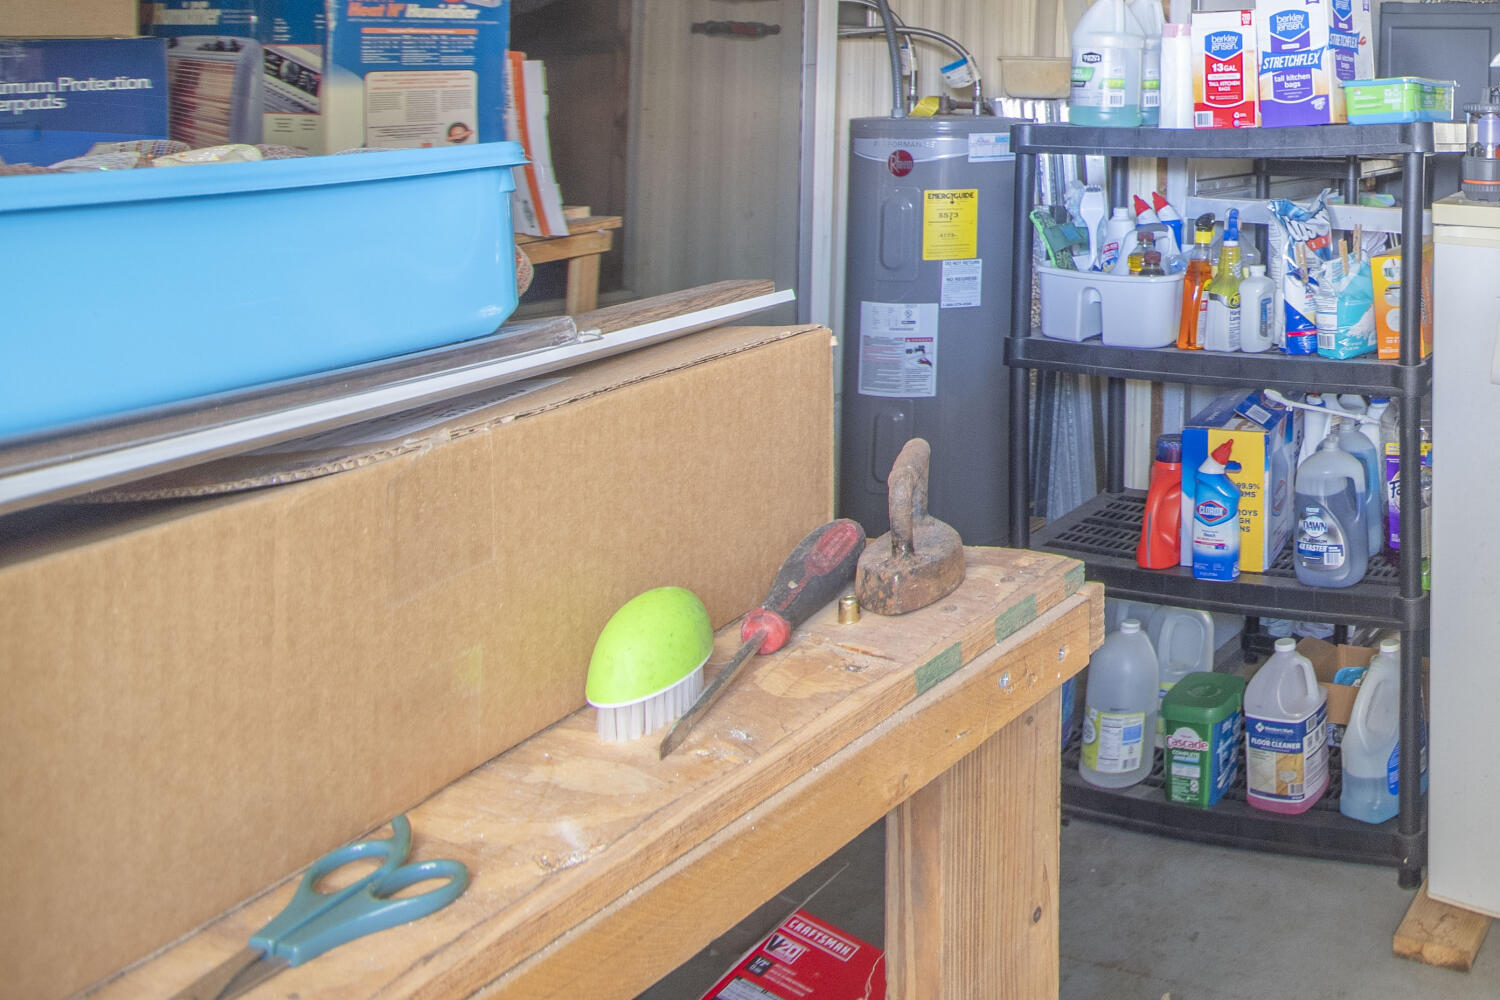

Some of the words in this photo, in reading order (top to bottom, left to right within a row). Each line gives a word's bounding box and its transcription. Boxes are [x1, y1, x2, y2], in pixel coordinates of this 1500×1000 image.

[1276, 13, 1305, 24] berkley
[1211, 34, 1239, 44] berkley
[1212, 62, 1224, 72] 13
[1224, 64, 1238, 72] GAL
[1263, 51, 1321, 70] STRETCHFLEX
[1286, 73, 1311, 81] kitchen
[57, 76, 153, 92] Protection
[1284, 81, 1301, 89] bags
[1303, 520, 1328, 533] DAWN
[1166, 735, 1208, 752] Cascade
[1251, 737, 1271, 747] FLOOR
[1271, 741, 1301, 750] CLEANER
[788, 919, 852, 956] CRAFTSMAN
[766, 934, 799, 960] V20
